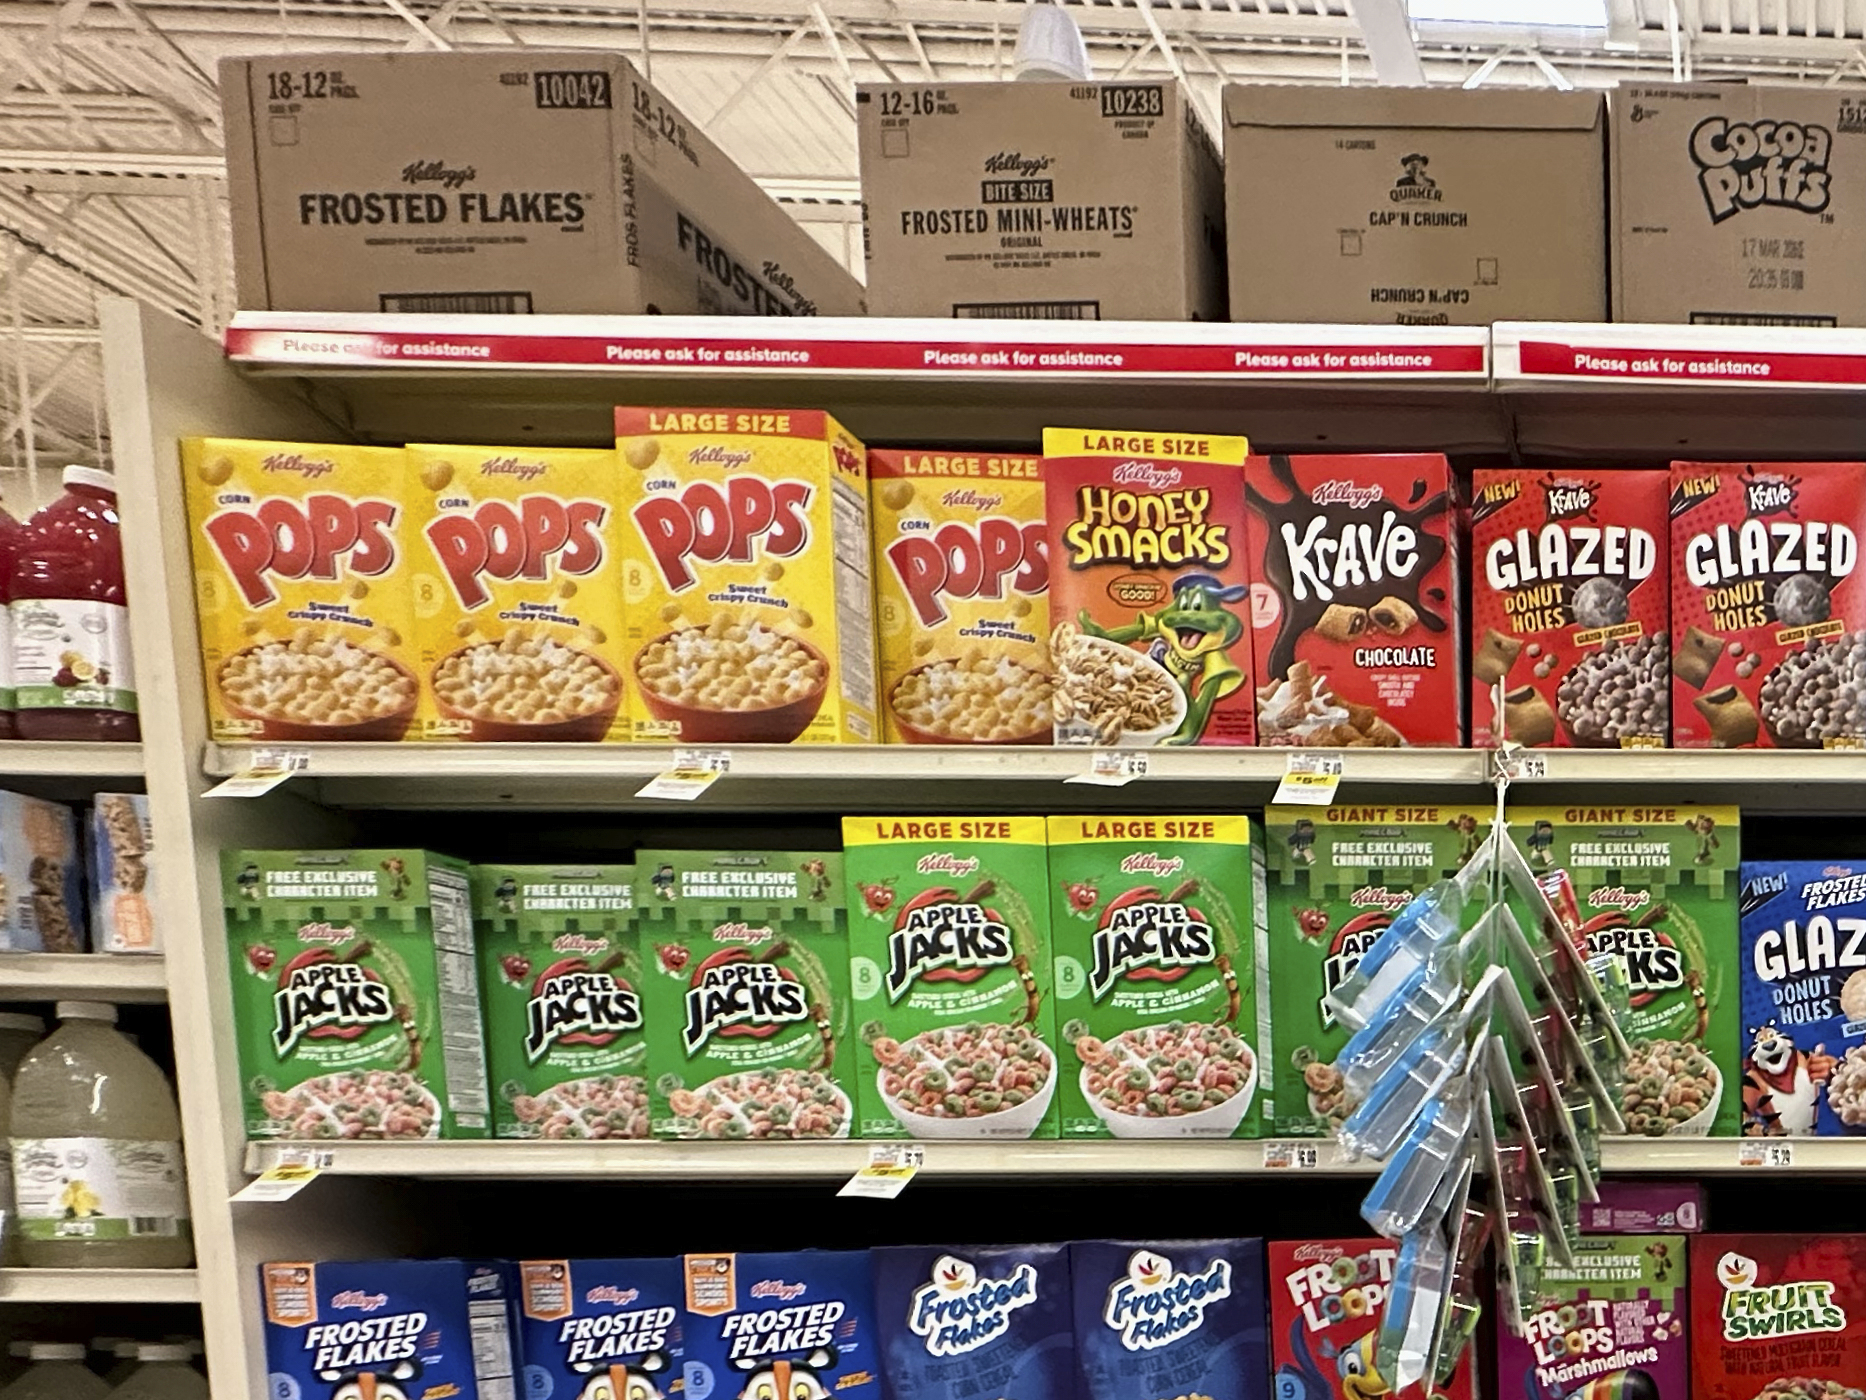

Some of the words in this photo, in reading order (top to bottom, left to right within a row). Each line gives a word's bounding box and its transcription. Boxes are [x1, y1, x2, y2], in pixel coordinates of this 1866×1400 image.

[267, 72, 327, 99] 18-12
[537, 74, 608, 107] 10042
[879, 91, 935, 117] 12-16
[1102, 88, 1161, 116] 10238
[1689, 116, 1831, 168] Cocoa
[984, 183, 1016, 200] BITE
[1019, 182, 1051, 200] SIZE
[1389, 187, 1443, 202] QUAKER
[300, 192, 447, 225] FROSTED
[459, 192, 585, 224] FLAKES
[901, 208, 989, 235] FROSTED
[997, 207, 1133, 232] MINI-WHEATS
[1369, 212, 1409, 226] CAP'N
[1414, 211, 1468, 227] CRUNCH
[1574, 356, 1628, 372] Please
[1631, 358, 1659, 372] ask
[1662, 358, 1686, 374] for
[1688, 359, 1770, 376] assistance
[649, 412, 728, 432] LARGE
[735, 414, 791, 433] SIZE
[1083, 435, 1156, 454] LARGE
[1163, 437, 1210, 456] SIZE
[481, 457, 547, 480] Kellogg's
[218, 494, 252, 505] CORN
[1081, 487, 1209, 526] HONEY
[633, 477, 813, 592] POPS
[900, 521, 930, 530] CORN
[205, 495, 395, 609] POPS
[427, 498, 607, 610] POPS
[1067, 521, 1232, 566] SMACKS
[1486, 524, 1657, 585] GLAZED
[1685, 521, 1858, 585] GLAZED
[728, 584, 767, 594] Sweet
[1705, 581, 1765, 611] DONUT
[1511, 605, 1565, 632] HOLES
[959, 626, 997, 640] Crispy
[998, 629, 1036, 643] Crunch
[1355, 647, 1436, 668] CHOCOLATE
[1326, 807, 1383, 823] GIANT
[1394, 807, 1439, 823] SIZE
[1565, 808, 1616, 823] GIANT
[1627, 807, 1677, 823] SIZE
[266, 871, 299, 884] FREE
[303, 871, 378, 884] EXCLUSIVE
[682, 871, 714, 884] FREE
[719, 871, 796, 884] EXCLUSIVE
[916, 854, 981, 874] Kellogg's
[1751, 871, 1789, 894] NEW!
[524, 897, 594, 910] CHARACTER
[598, 897, 632, 910] ITEM
[1588, 887, 1650, 908] Kellogg's
[1111, 902, 1187, 932] APPLE
[890, 924, 1009, 997] JACKS
[544, 973, 613, 998] APPLE
[1772, 973, 1832, 1002] DONUT
[276, 981, 392, 1057] JACKS
[686, 981, 807, 1056] JACKS
[1571, 1256, 1641, 1267] EXCLUSIVE
[1724, 1283, 1835, 1316] FRUIT
[305, 1312, 427, 1348] FROSTED
[721, 1301, 844, 1339] FROSTED
[1725, 1307, 1845, 1338] SWIRLS
[567, 1329, 667, 1362] FLAKES
[1537, 1346, 1659, 1387] Marshmallows
[1281, 1381, 1296, 1399] 9
